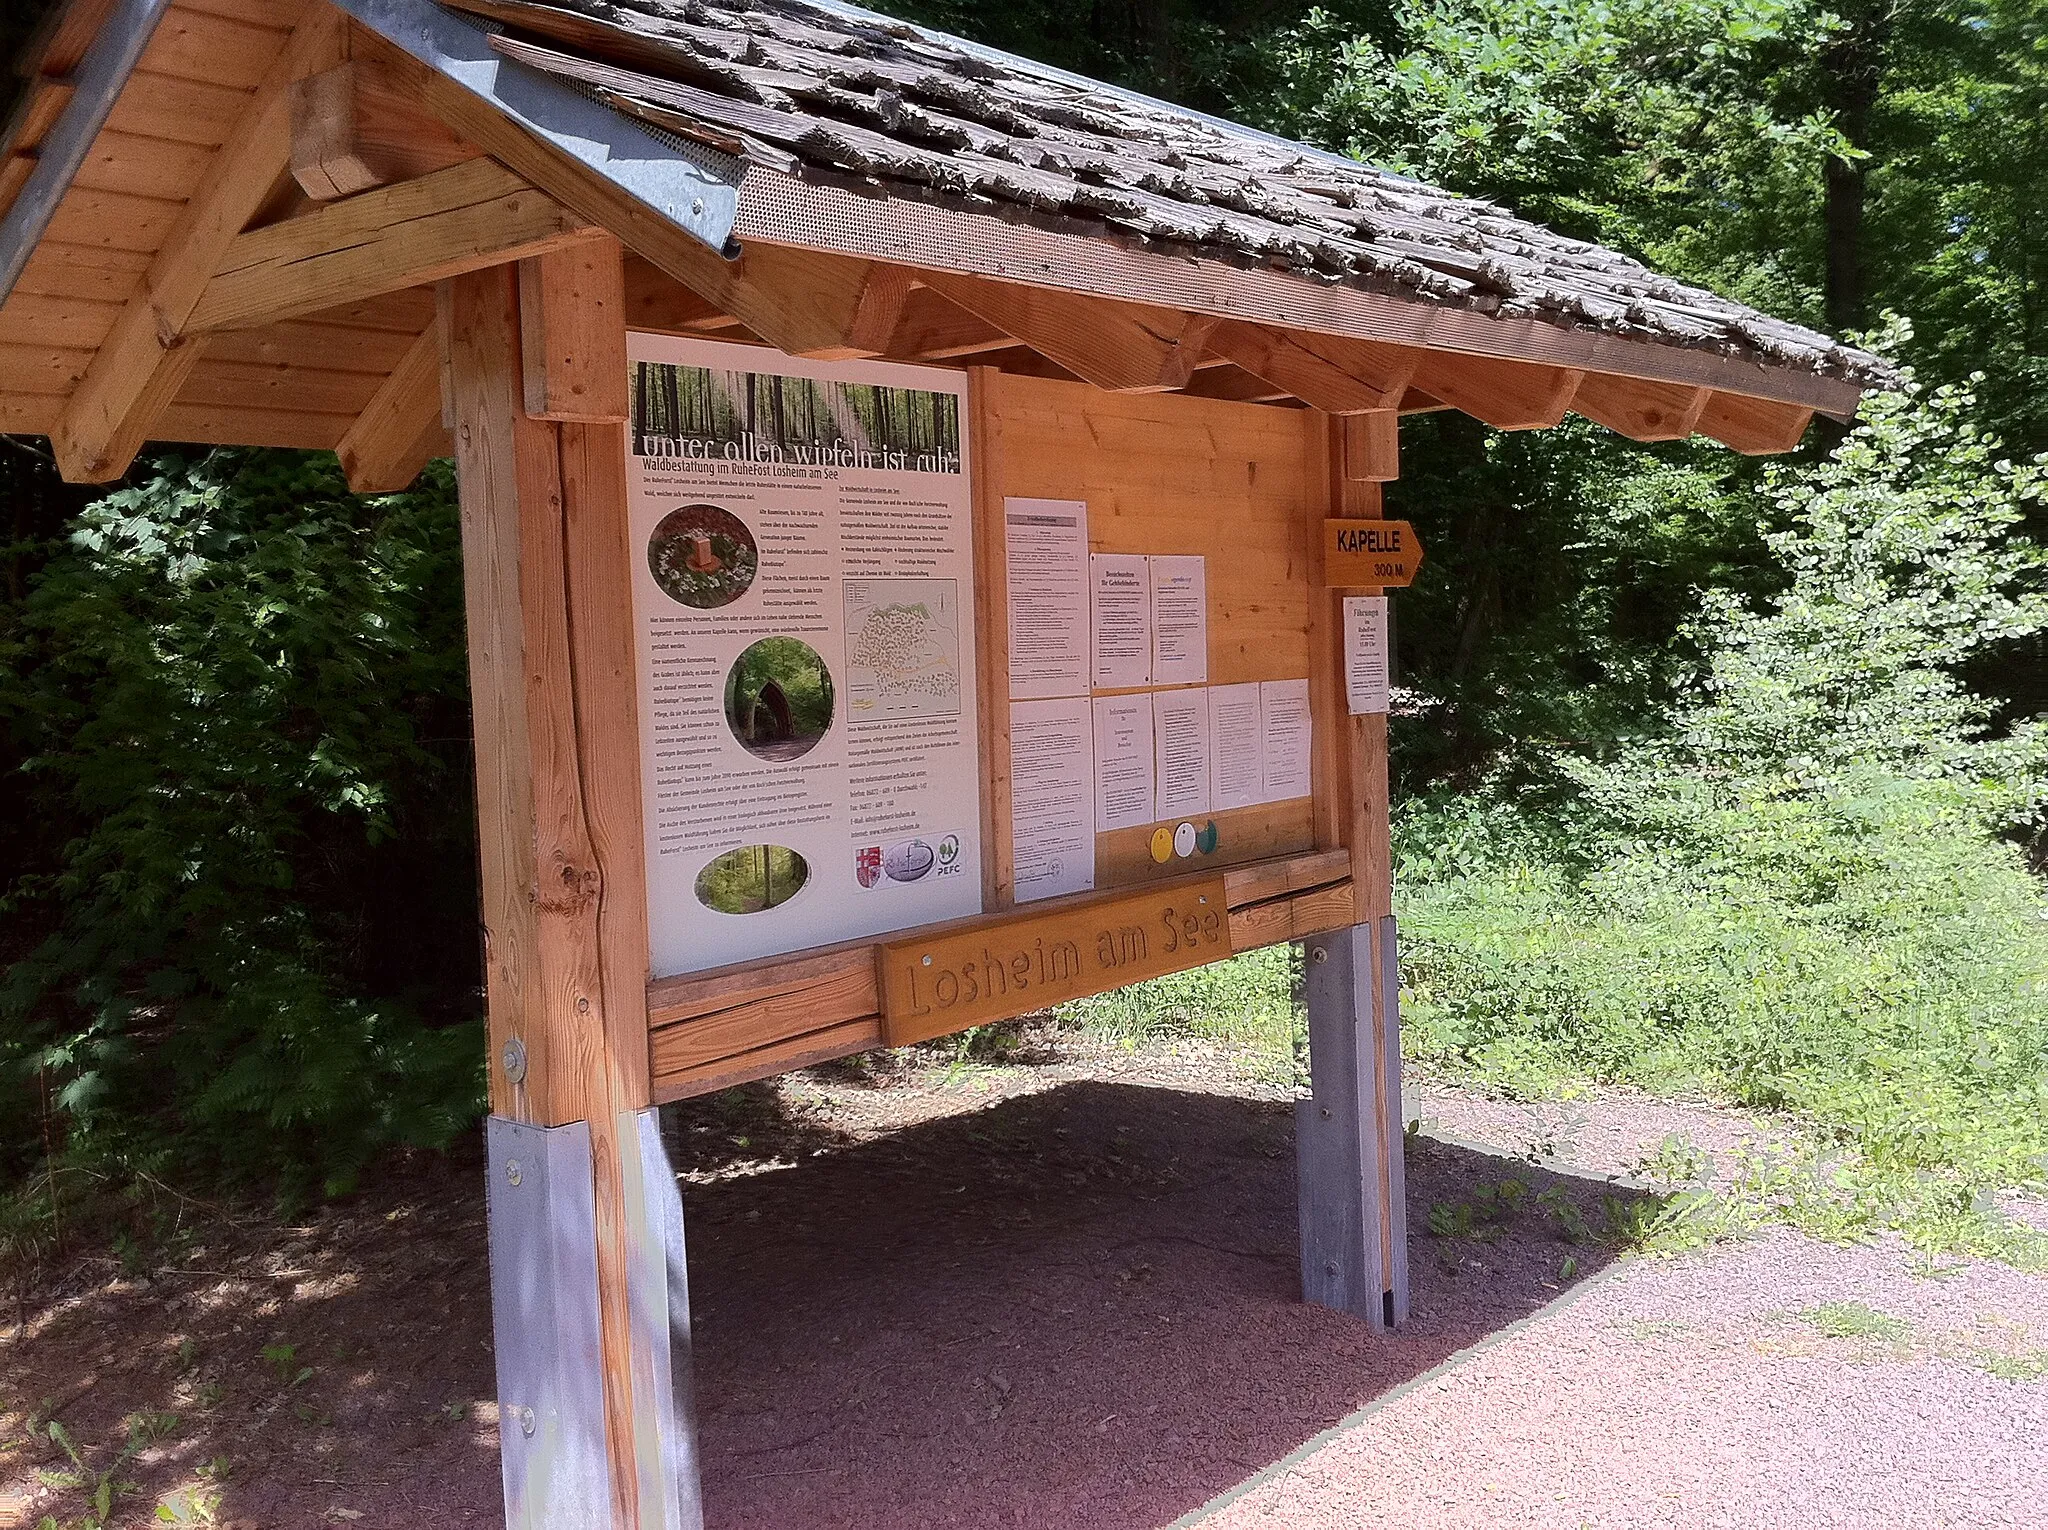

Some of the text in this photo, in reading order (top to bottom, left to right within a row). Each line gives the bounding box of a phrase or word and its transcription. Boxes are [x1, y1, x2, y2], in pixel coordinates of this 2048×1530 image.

[642, 433, 714, 459] unter
[724, 431, 783, 463] allen
[793, 437, 872, 469] wipfeln
[883, 444, 908, 471] ist
[642, 458, 714, 476] Waldbestattung
[717, 463, 729, 474] im
[773, 465, 807, 479] Losheim
[809, 470, 821, 479] am
[824, 468, 838, 480] See
[1337, 529, 1401, 552] KAPELLE
[1374, 563, 1404, 577] 300 M
[937, 864, 960, 877] PEFC
[906, 907, 1222, 1017] Losheim am See
